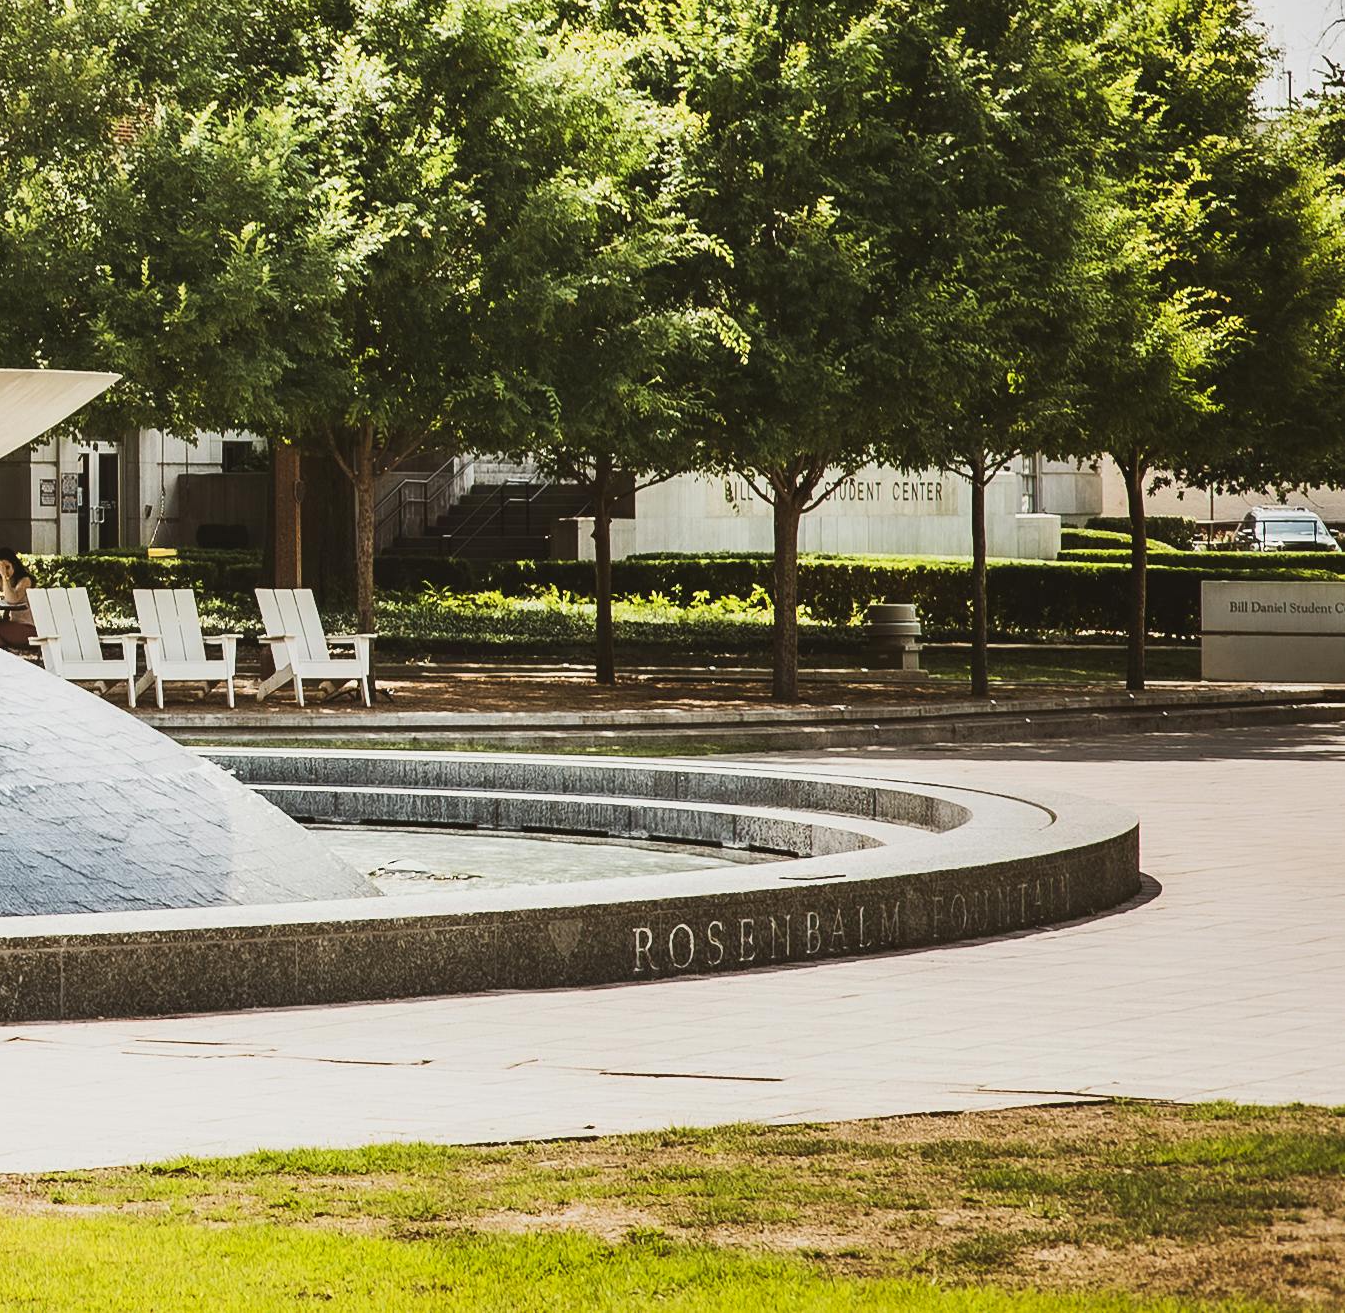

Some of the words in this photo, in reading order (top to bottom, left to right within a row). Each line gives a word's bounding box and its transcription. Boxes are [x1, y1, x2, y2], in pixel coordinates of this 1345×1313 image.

[825, 481, 881, 501] STUDENT
[893, 481, 943, 501] CENTER
[1230, 601, 1248, 613] Bill
[1251, 601, 1287, 614] Daniel
[1290, 602, 1332, 614] Student
[632, 902, 900, 972] ROSENBALM
[933, 872, 1071, 938] FOUNTAIN
